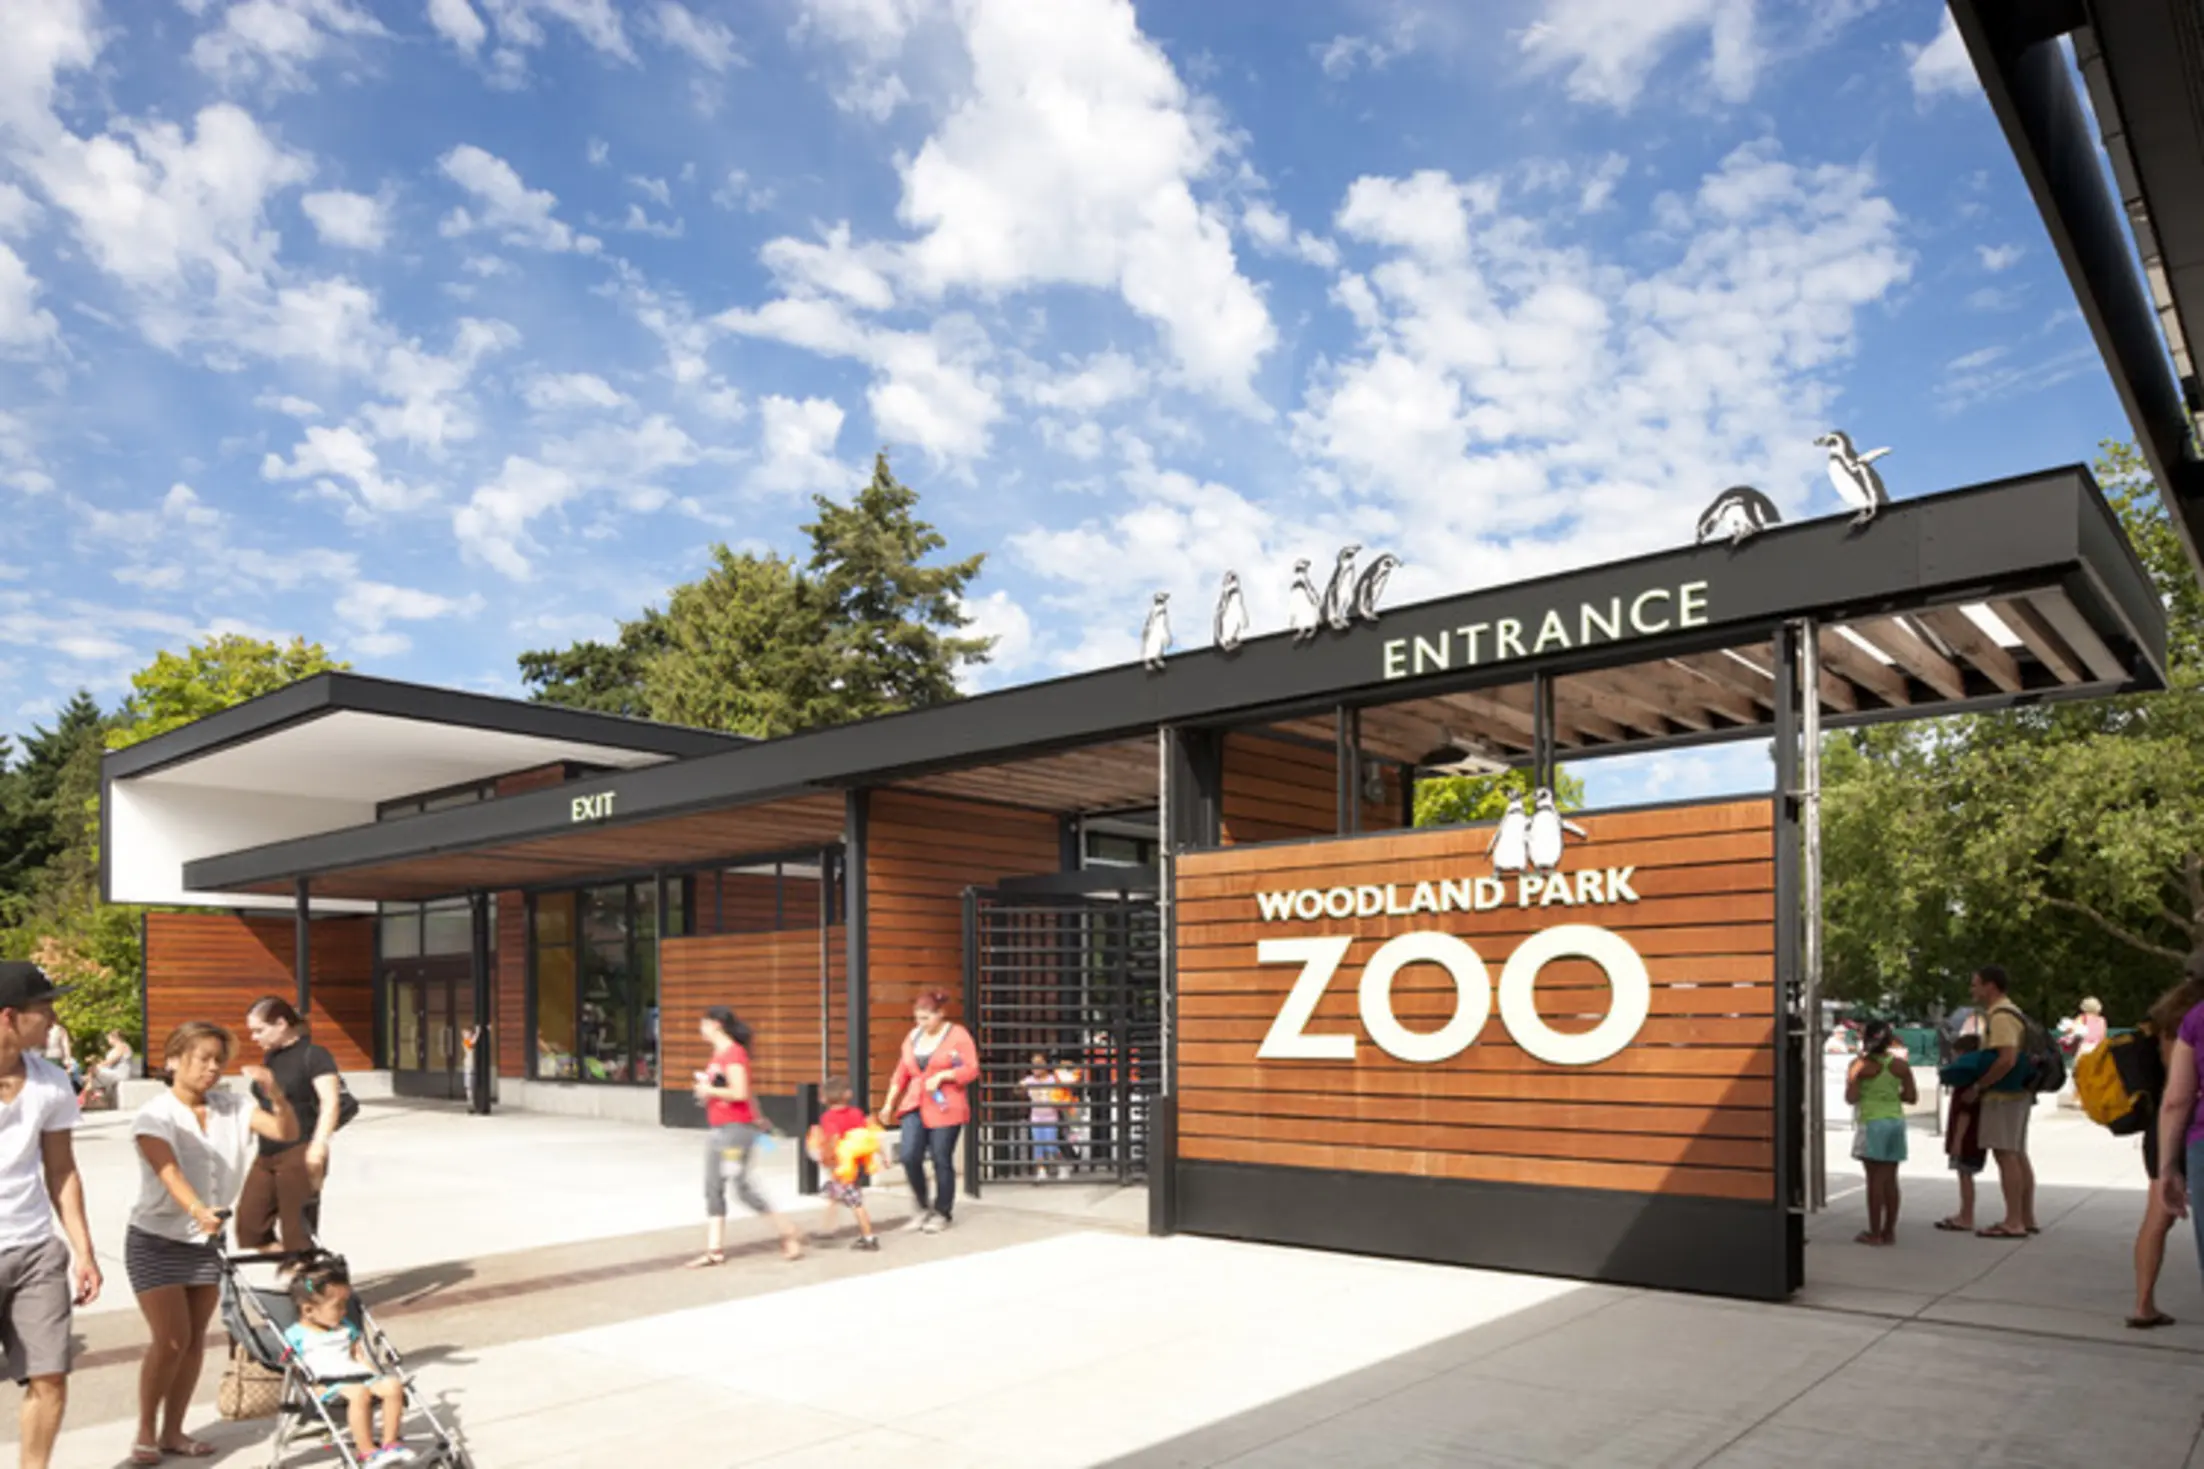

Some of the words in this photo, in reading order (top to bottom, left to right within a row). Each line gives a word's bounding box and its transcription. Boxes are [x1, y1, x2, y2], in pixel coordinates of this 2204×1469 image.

[1383, 581, 1709, 679] ENTRANCE
[572, 791, 616, 822] EXIT
[1257, 877, 1504, 921] WOODLAND
[1518, 866, 1639, 908] PARK
[1256, 924, 1651, 1065] ZOO
